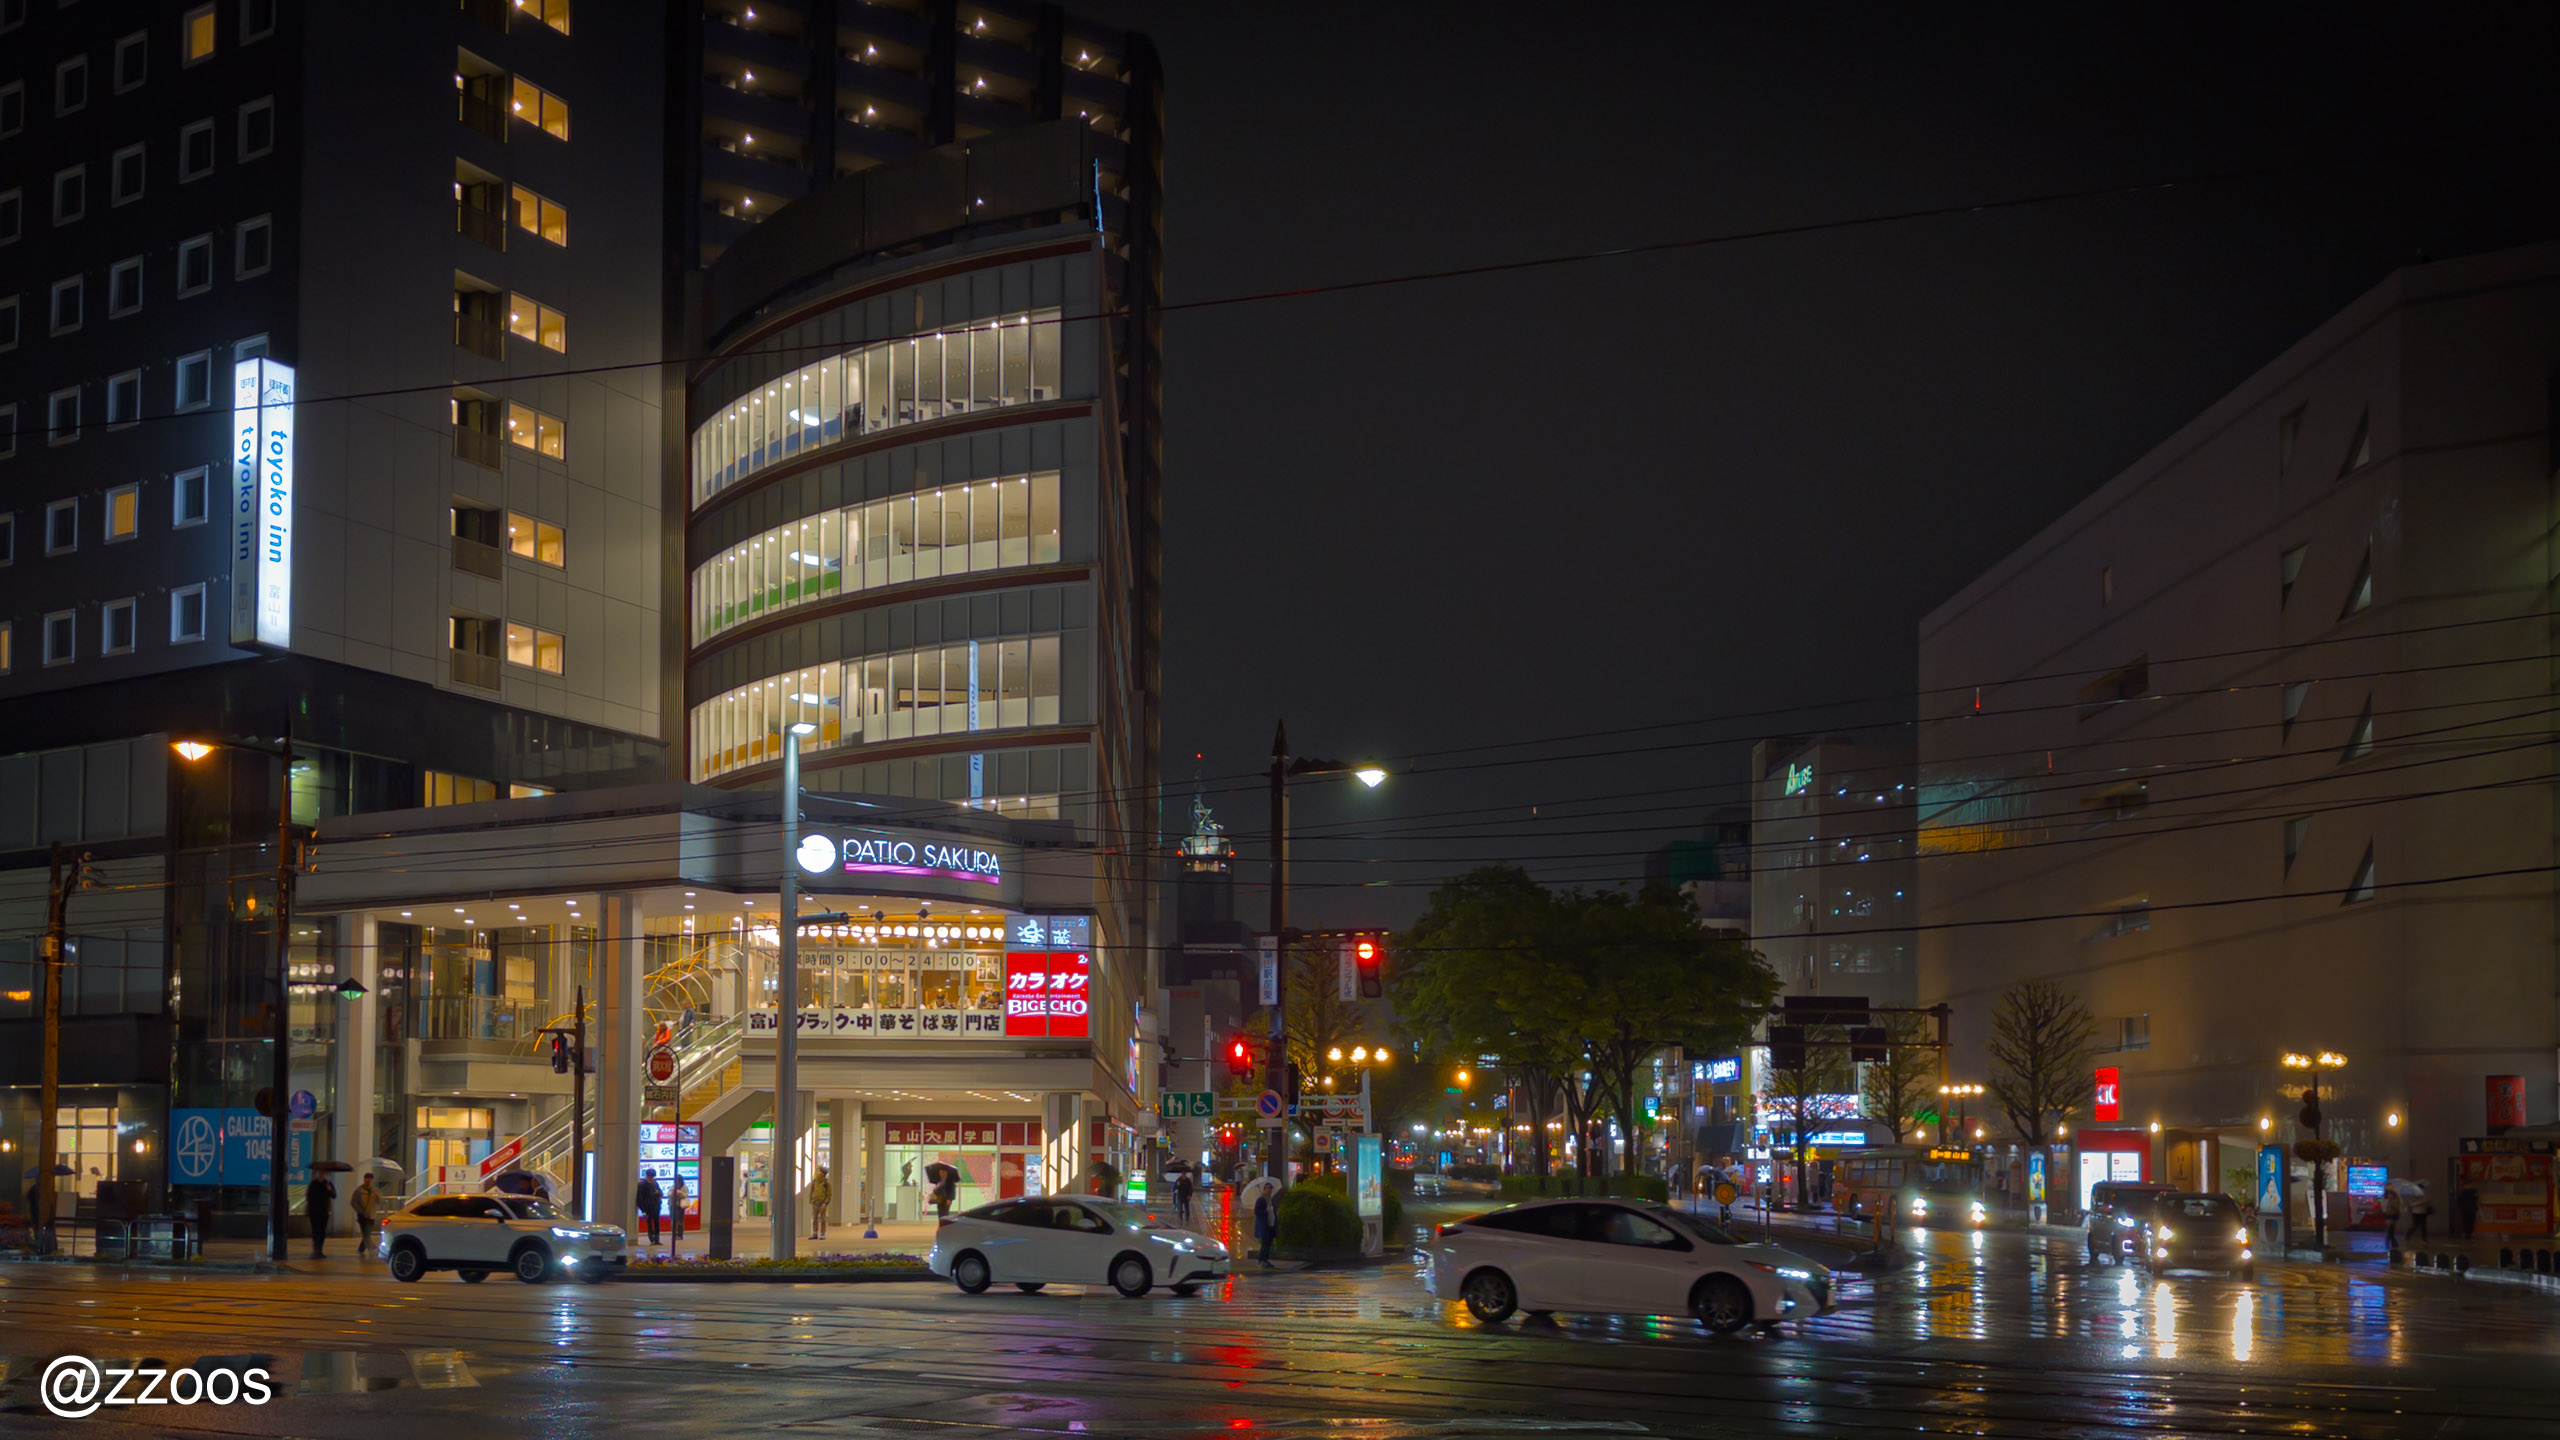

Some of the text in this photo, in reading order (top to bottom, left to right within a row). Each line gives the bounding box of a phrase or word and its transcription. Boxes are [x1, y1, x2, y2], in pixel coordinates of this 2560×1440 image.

[267, 429, 288, 516] toyoko
[239, 426, 254, 561] toyoko inn
[268, 524, 287, 563] inn
[842, 837, 1000, 876] PATIO SAKURA
[1008, 972, 1088, 989] カラオケ
[1008, 999, 1088, 1015] BIGECHO
[227, 1116, 273, 1136] GALLERY
[888, 1129, 995, 1144] 富山大原学園
